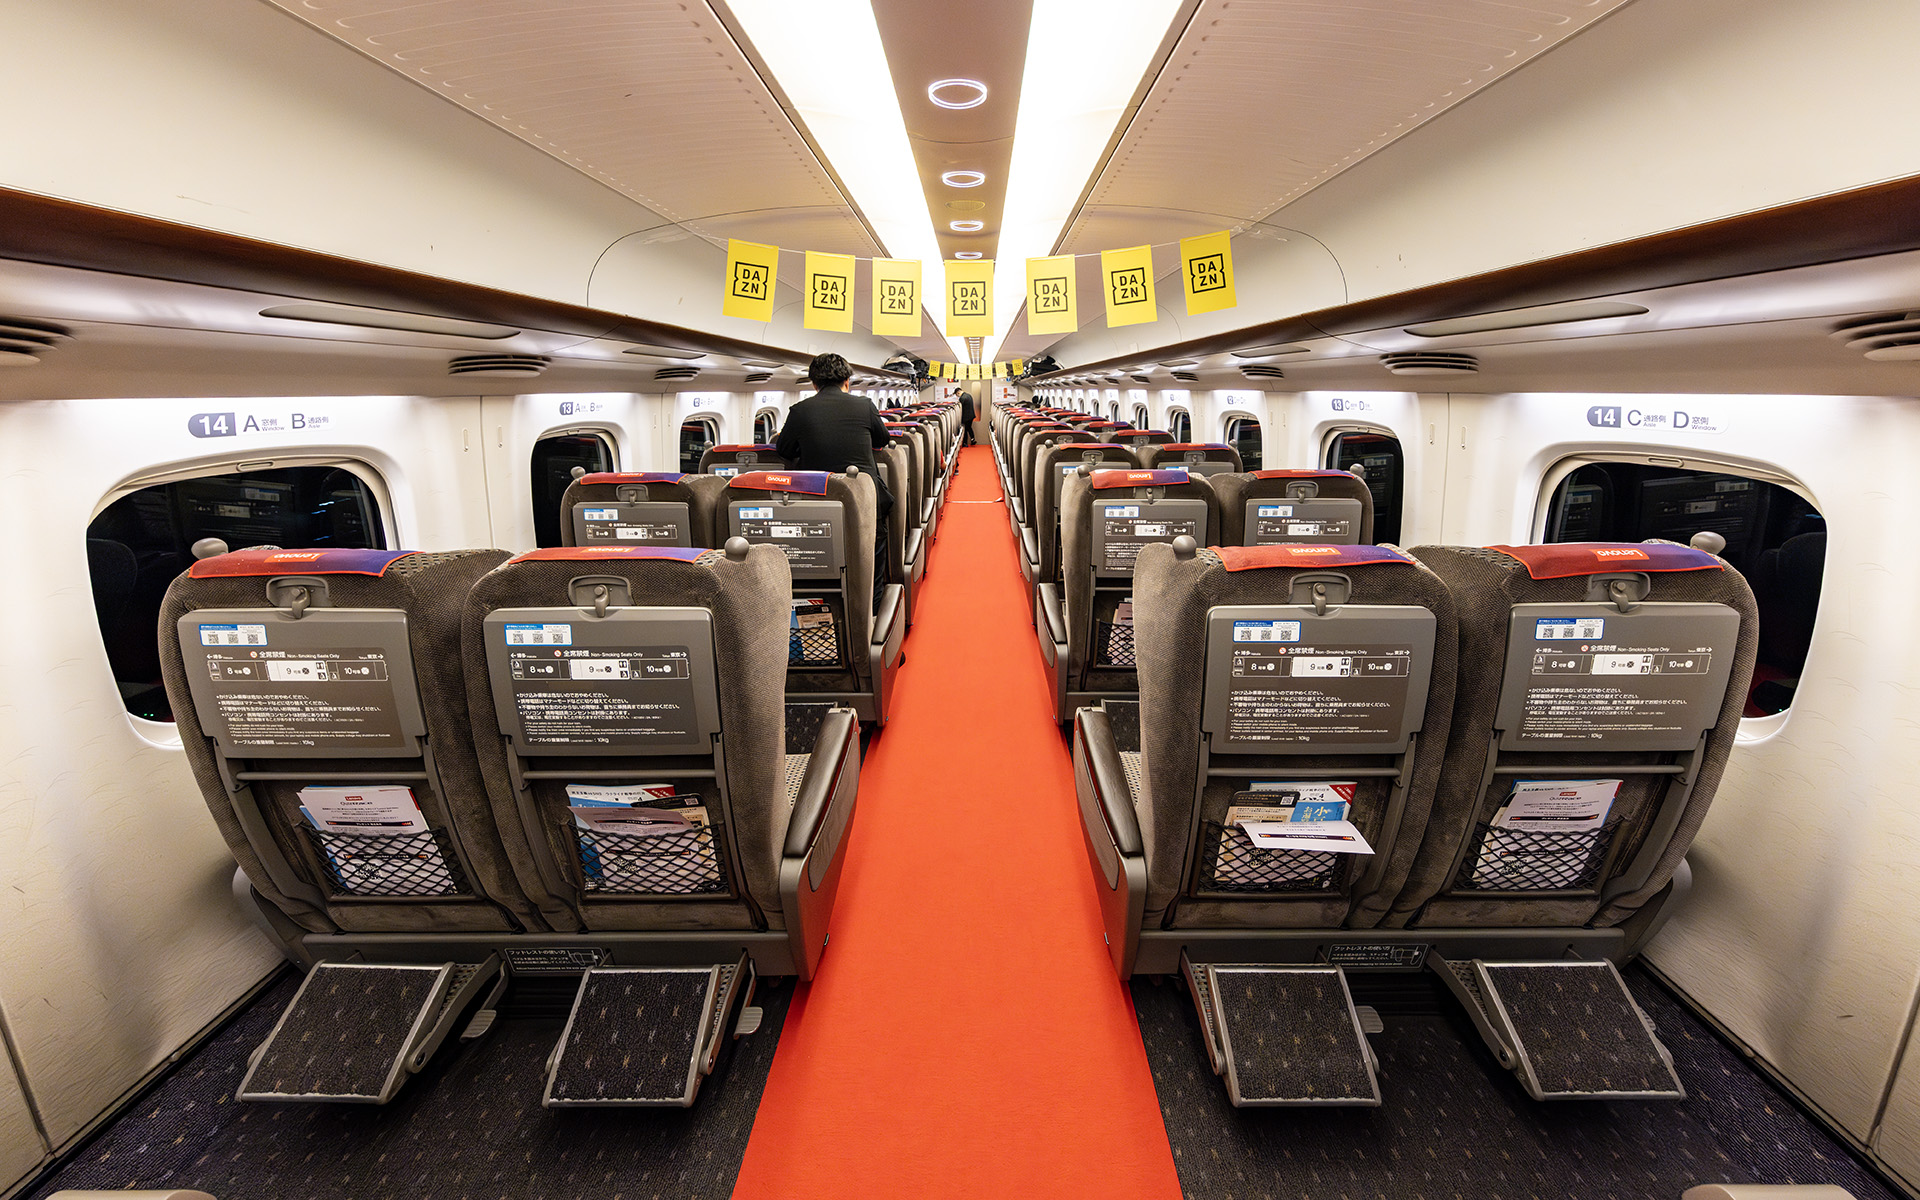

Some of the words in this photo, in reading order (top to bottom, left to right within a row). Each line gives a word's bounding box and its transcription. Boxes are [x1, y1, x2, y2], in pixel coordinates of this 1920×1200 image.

[562, 403, 572, 414] 13
[1333, 399, 1342, 410] 13
[1594, 408, 1616, 426] 14
[1627, 409, 1642, 426] C
[1673, 411, 1689, 428] D
[199, 415, 228, 435] 14
[243, 415, 260, 432] A
[292, 413, 306, 429] B
[274, 552, 320, 560] Lenovo
[1598, 548, 1643, 557] Lenovo
